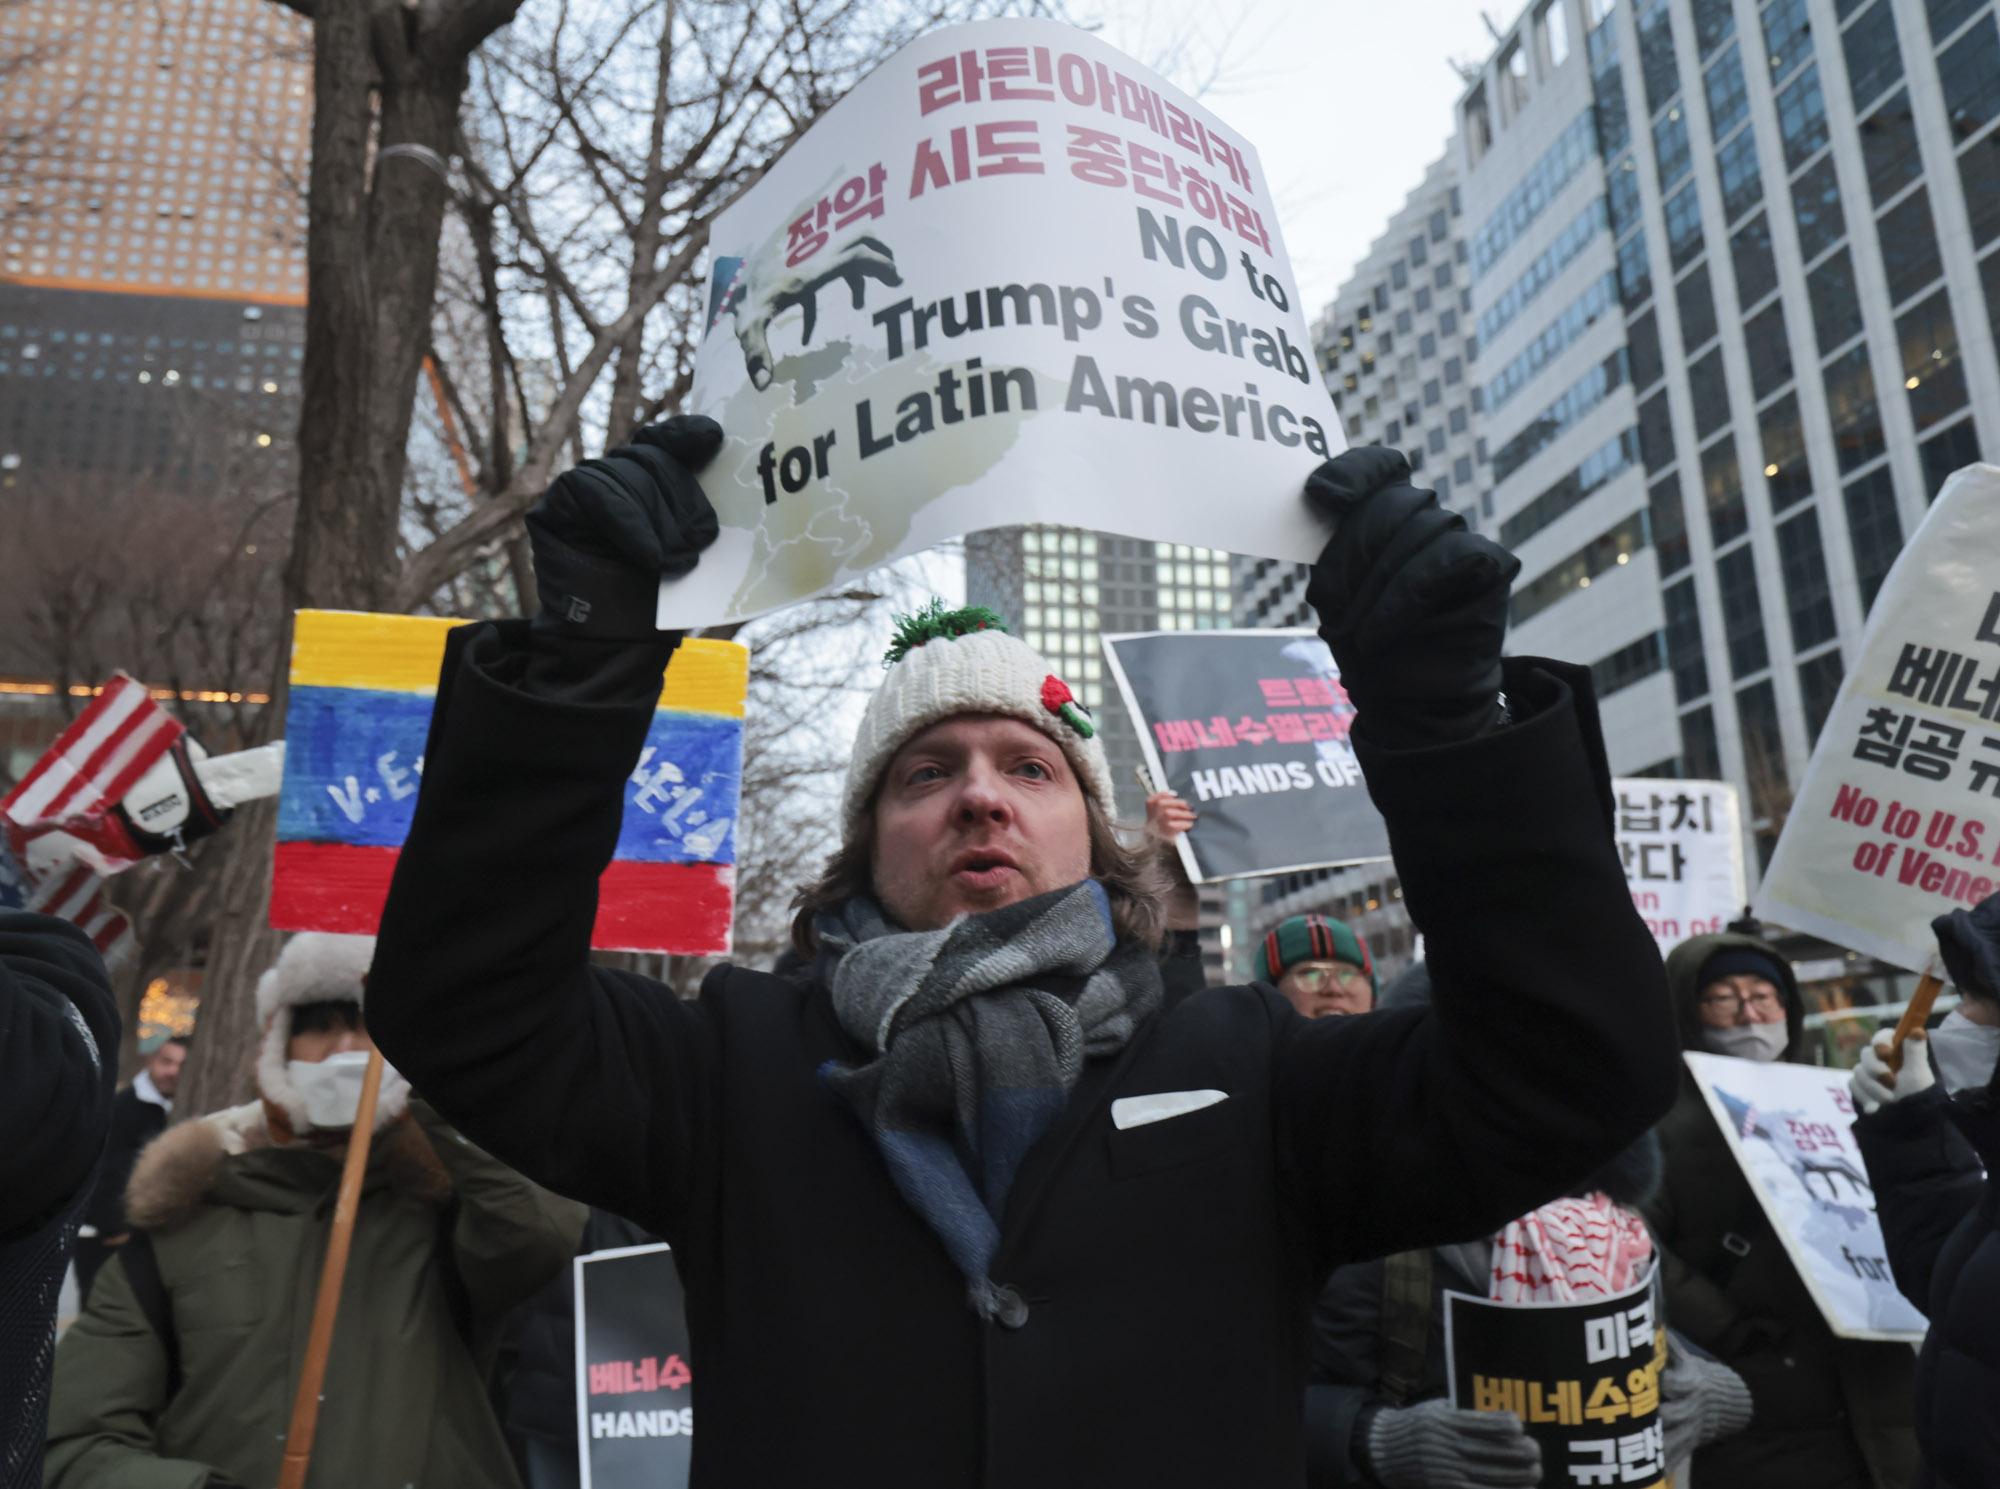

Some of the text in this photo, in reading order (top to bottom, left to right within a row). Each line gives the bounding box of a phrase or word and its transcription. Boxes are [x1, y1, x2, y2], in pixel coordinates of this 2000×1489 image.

[916, 45, 1254, 196] 라틴아메리카
[785, 121, 1274, 269] 장악 시도 중단하라
[1136, 206, 1290, 313] NO to
[872, 276, 1311, 385] Trump's Grab
[756, 354, 1331, 505] for Latin America
[1853, 707, 1966, 782] 침공
[1191, 760, 1315, 801] HANDS
[1619, 793, 1713, 833] 납치
[1830, 783, 1879, 828] No
[1881, 800, 1922, 840] to
[1924, 809, 1986, 862] U.S.
[1852, 841, 1898, 878] of
[1898, 846, 2000, 907] Vene
[1690, 916, 1722, 938] of
[1841, 1245, 1891, 1284] for
[588, 1354, 692, 1395] 베네수
[591, 1406, 694, 1438] HANDS
